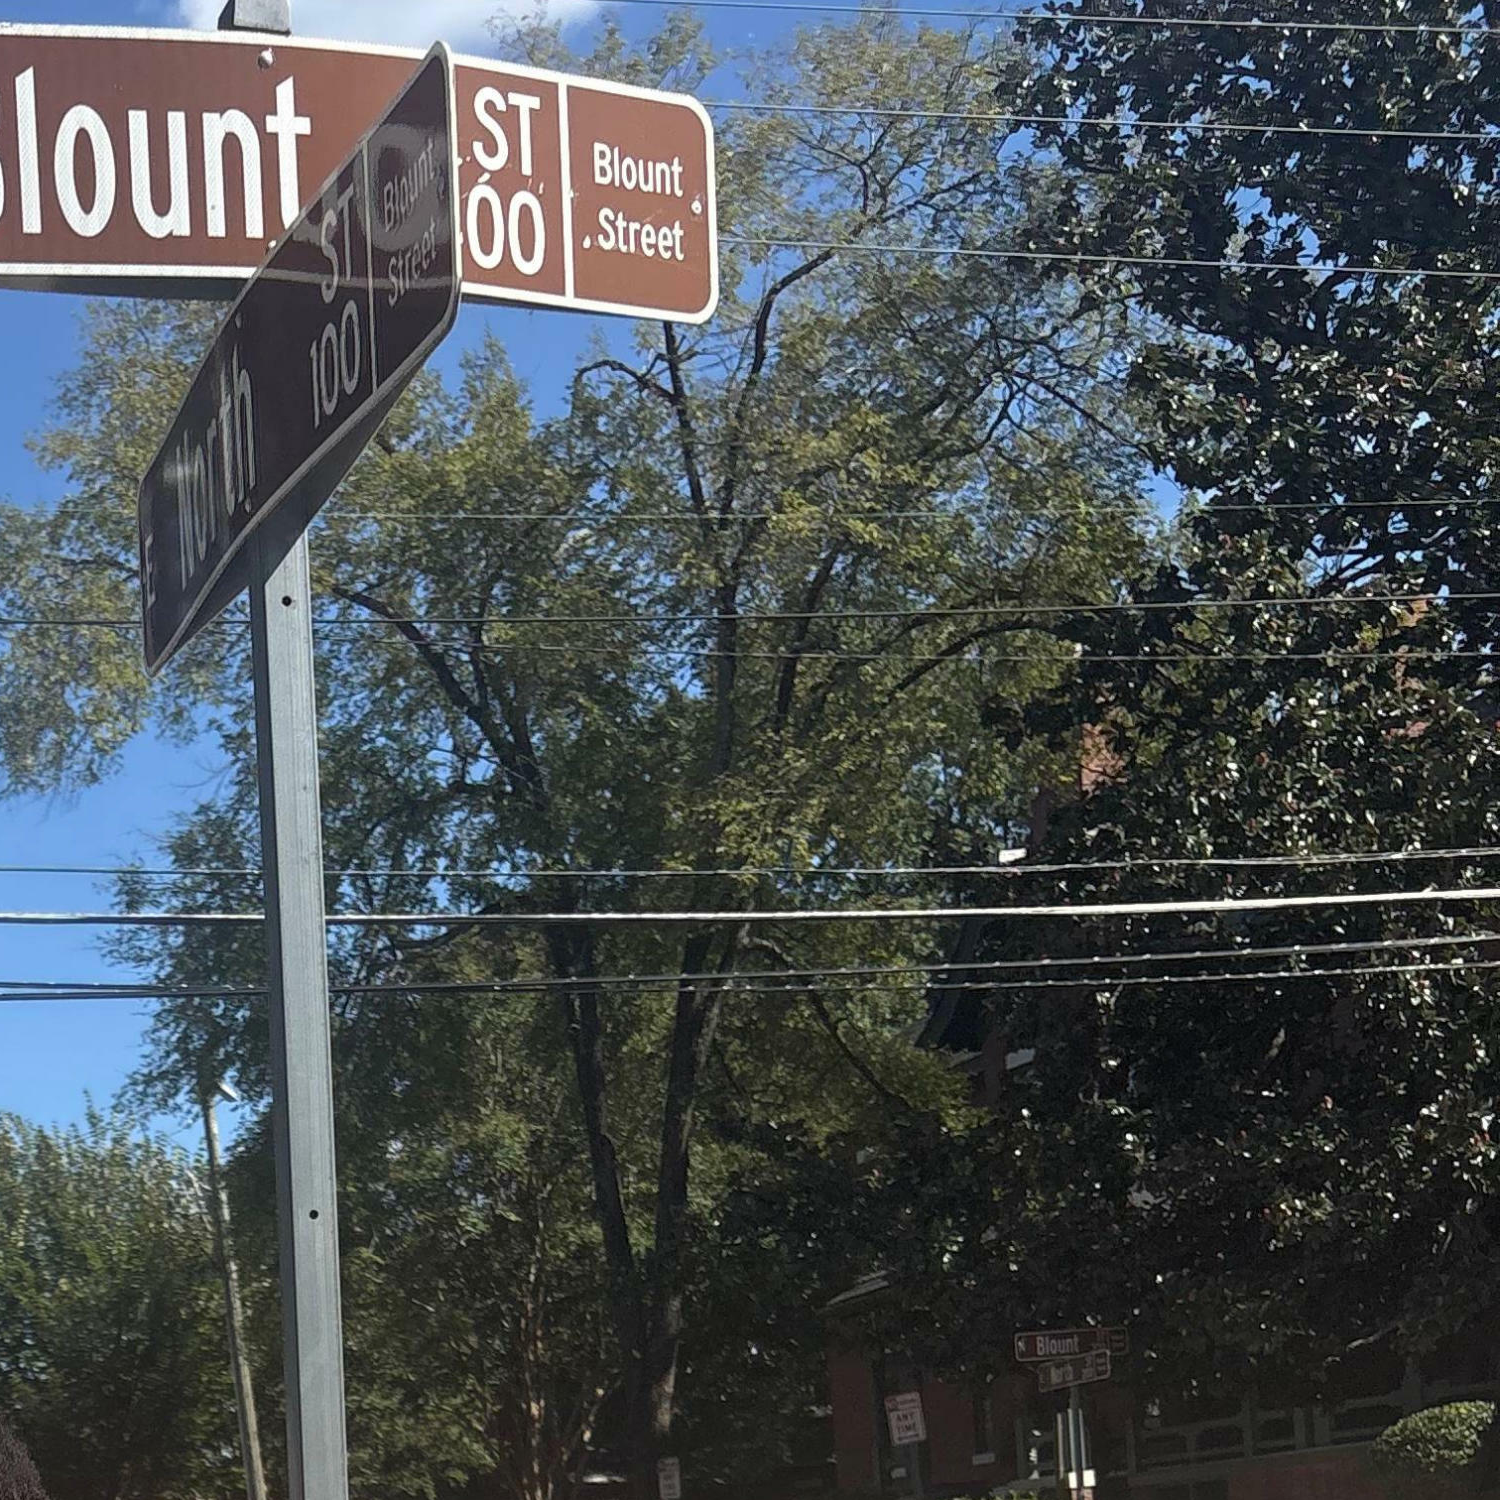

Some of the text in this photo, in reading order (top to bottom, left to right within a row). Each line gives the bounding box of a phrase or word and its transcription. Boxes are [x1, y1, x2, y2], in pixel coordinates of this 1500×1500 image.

[472, 86, 541, 176] ST
[592, 141, 684, 198] Blount
[383, 135, 436, 233] Blount
[466, 184, 546, 276] 00
[320, 182, 354, 304] ST
[387, 214, 438, 308] Street
[597, 207, 685, 261] Street
[309, 302, 363, 428] 100
[1036, 1335, 1079, 1356] Blount
